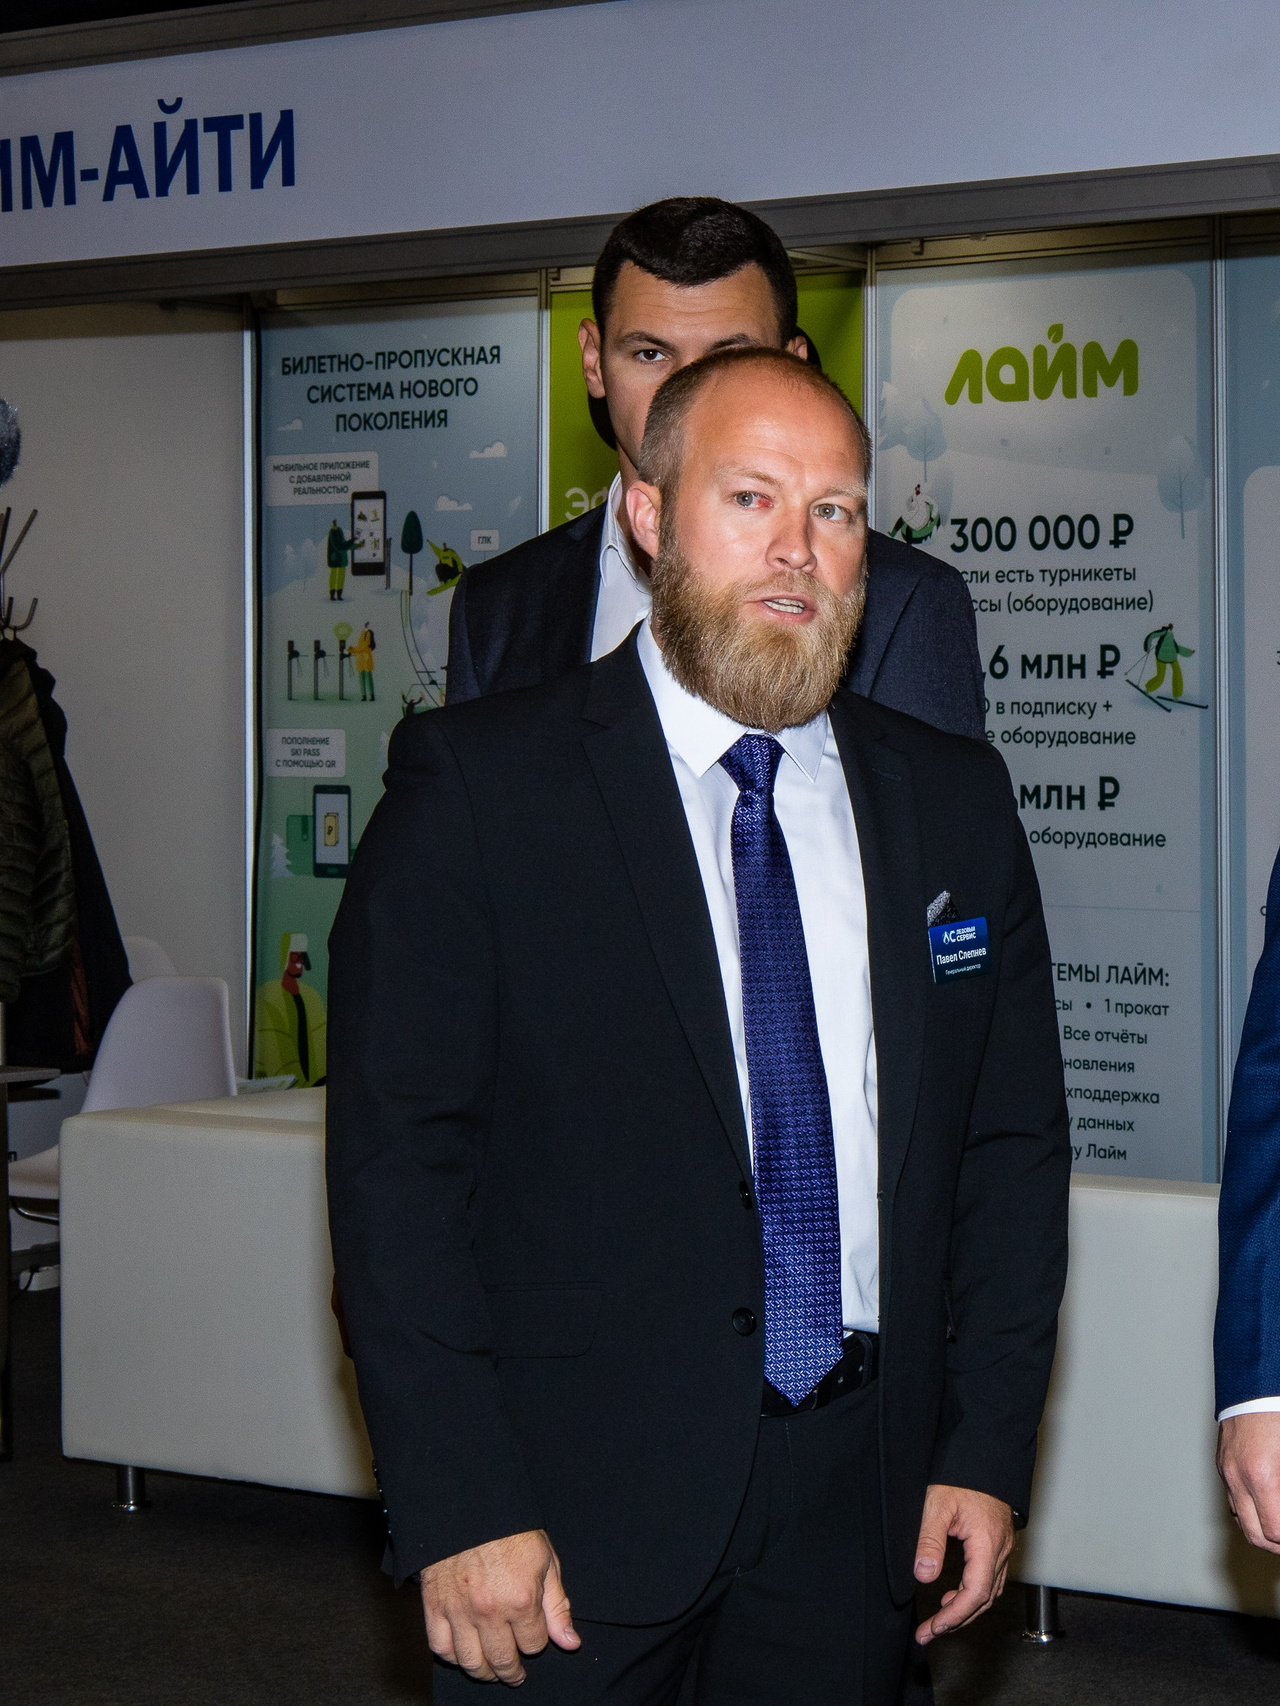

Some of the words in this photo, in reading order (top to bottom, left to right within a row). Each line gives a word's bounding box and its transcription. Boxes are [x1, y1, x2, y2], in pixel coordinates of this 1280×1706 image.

[0, 97, 296, 213] М-АЙТИ
[281, 345, 501, 376] БИЛЕТНО-ПРОПУСКНАЯ
[306, 380, 395, 405] СИСТЕМА
[400, 377, 479, 401] НОВОГО
[335, 409, 449, 433] ПОКОЛЕНИЯ
[273, 462, 319, 472] МОБИЛЬНОЕ
[320, 460, 370, 470] ПРИЛОЖЕНИЕ
[289, 475, 295, 483] С
[296, 471, 352, 484] ДОБАВЛЕННОЙ
[293, 485, 349, 496] РЕАЛЬНОСТЬЮ
[477, 535, 492, 545] ГЛК
[950, 516, 1017, 553] 300
[1028, 514, 1100, 551] 000
[994, 568, 1034, 583] есть
[1039, 567, 1136, 586] турникеты
[1007, 590, 1154, 616] (оборудование)
[1020, 653, 1087, 680] млн
[995, 702, 1006, 715] в
[1010, 701, 1098, 720] подписку
[281, 736, 330, 746] ПОПОЛНЕНИЕ
[1000, 726, 1137, 748] оборудование
[291, 748, 301, 757] SKI
[303, 748, 320, 757] PASS
[275, 759, 281, 768] С
[282, 759, 324, 768] ПОМОЩЬЮ
[325, 759, 336, 769] QR
[1019, 783, 1086, 810] млн
[1029, 826, 1167, 848] оборудование
[956, 932, 977, 942] СЕРВИС
[936, 953, 958, 966] Павел
[958, 947, 987, 960] Слепнев
[1105, 962, 1170, 987] ЛАЙМ:
[1104, 998, 1111, 1014] 1
[1115, 1002, 1170, 1017] прокат
[1063, 1025, 1091, 1041] Все
[1095, 1029, 1148, 1045] отчёты
[1077, 1117, 1135, 1131] данных
[1086, 1143, 1127, 1160] Лайм
